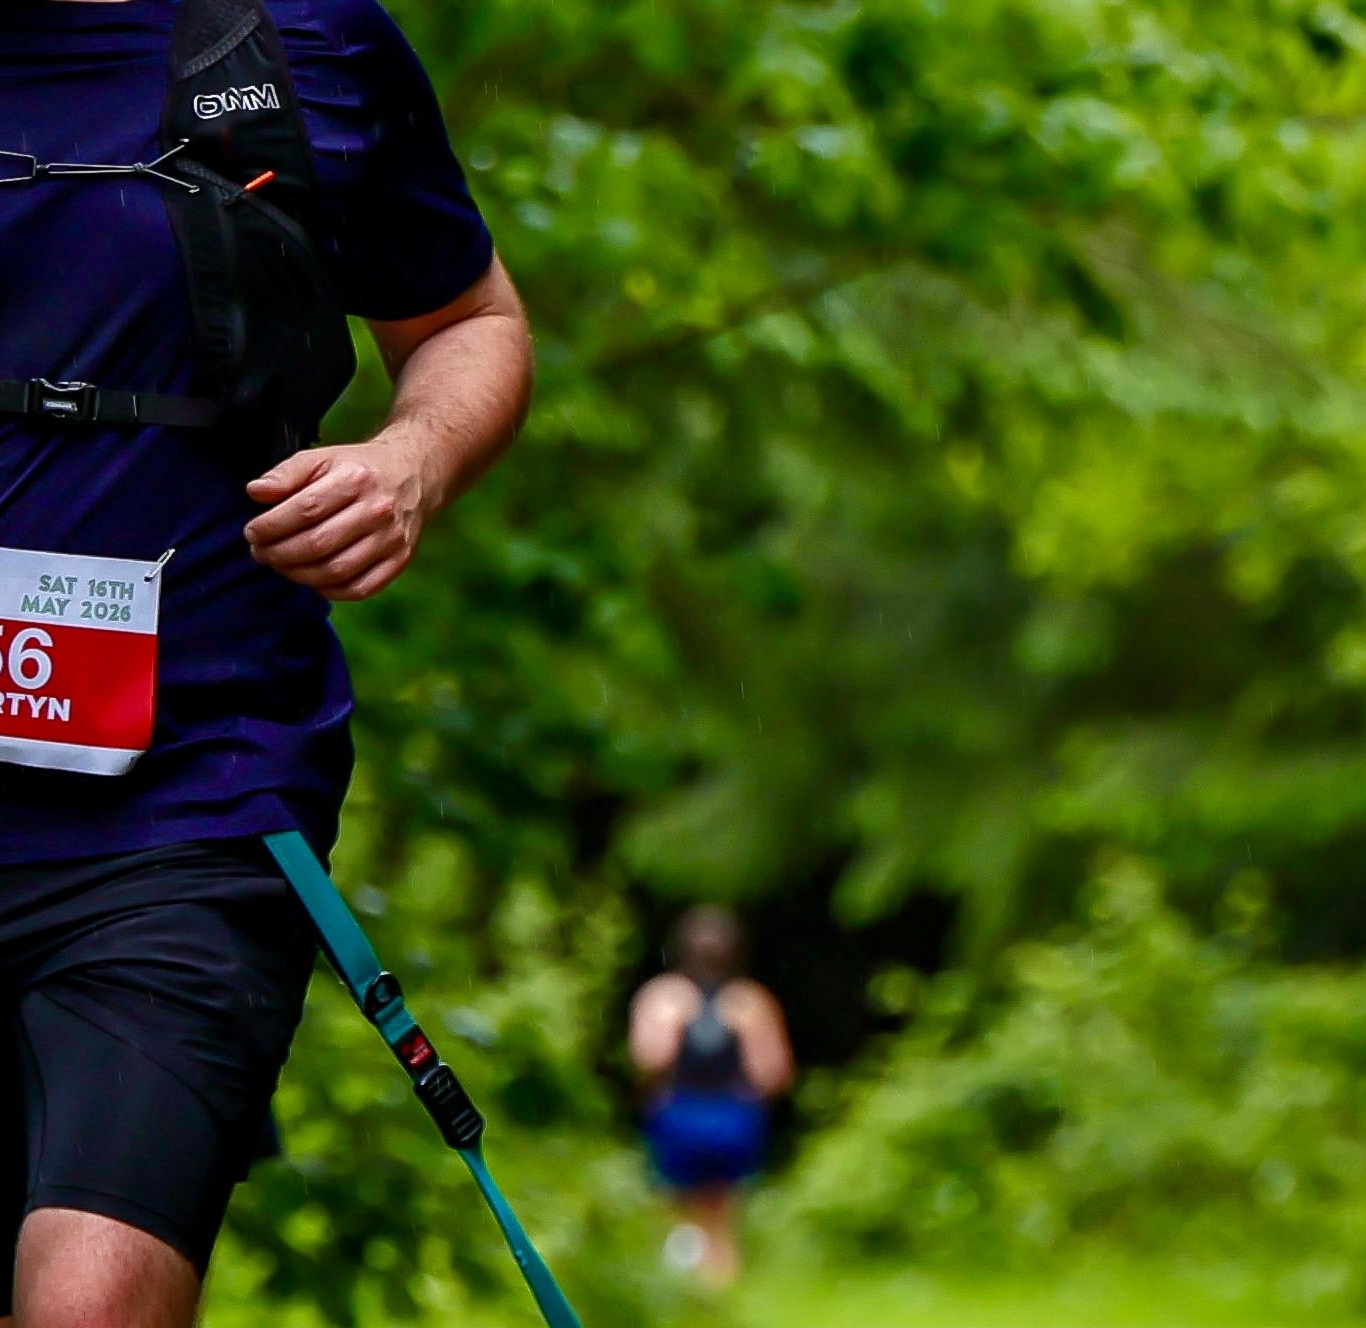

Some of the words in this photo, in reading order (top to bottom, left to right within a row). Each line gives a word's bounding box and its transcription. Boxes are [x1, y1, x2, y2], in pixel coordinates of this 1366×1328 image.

[194, 83, 280, 120] OMM
[38, 574, 78, 594] SAT
[88, 578, 135, 601] 16TH
[20, 594, 71, 616] MAY
[80, 601, 132, 622] 2026
